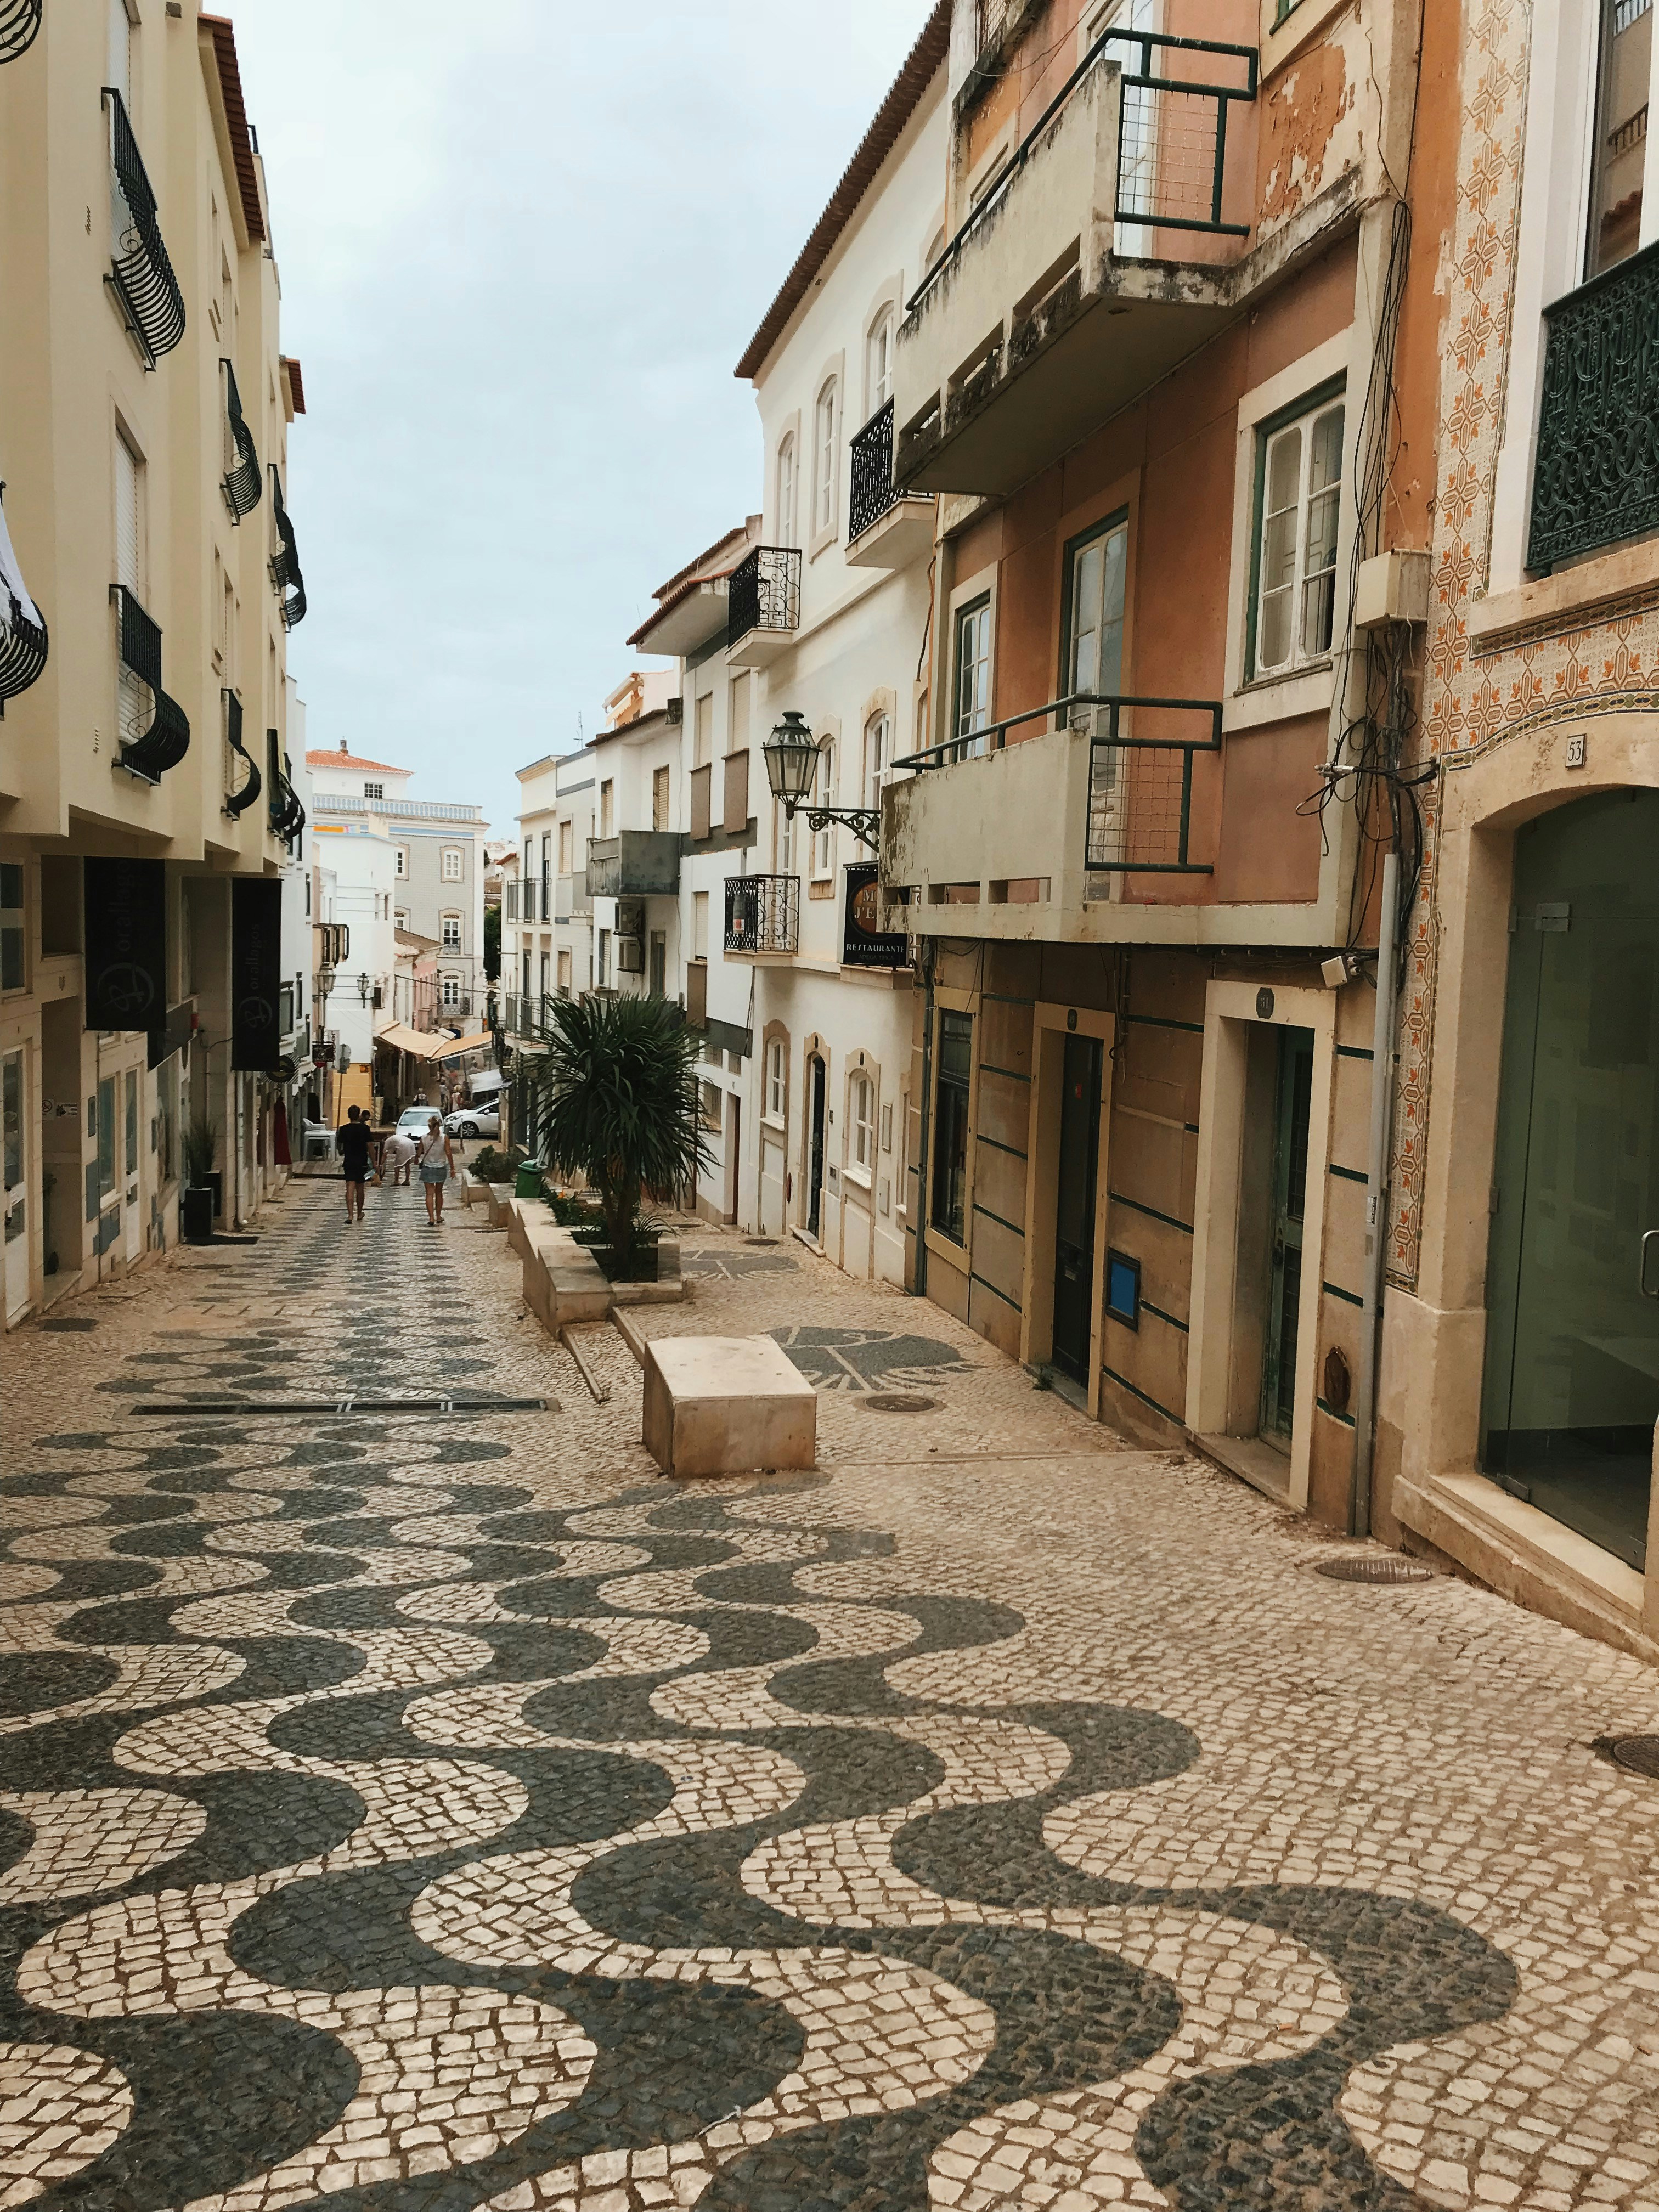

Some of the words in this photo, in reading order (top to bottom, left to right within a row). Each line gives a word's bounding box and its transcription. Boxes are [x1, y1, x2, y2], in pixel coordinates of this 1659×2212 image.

[1567, 740, 1582, 761] 53
[107, 860, 136, 952] orallago
[854, 906, 877, 919] J'E
[847, 943, 905, 953] RESTAURANTE
